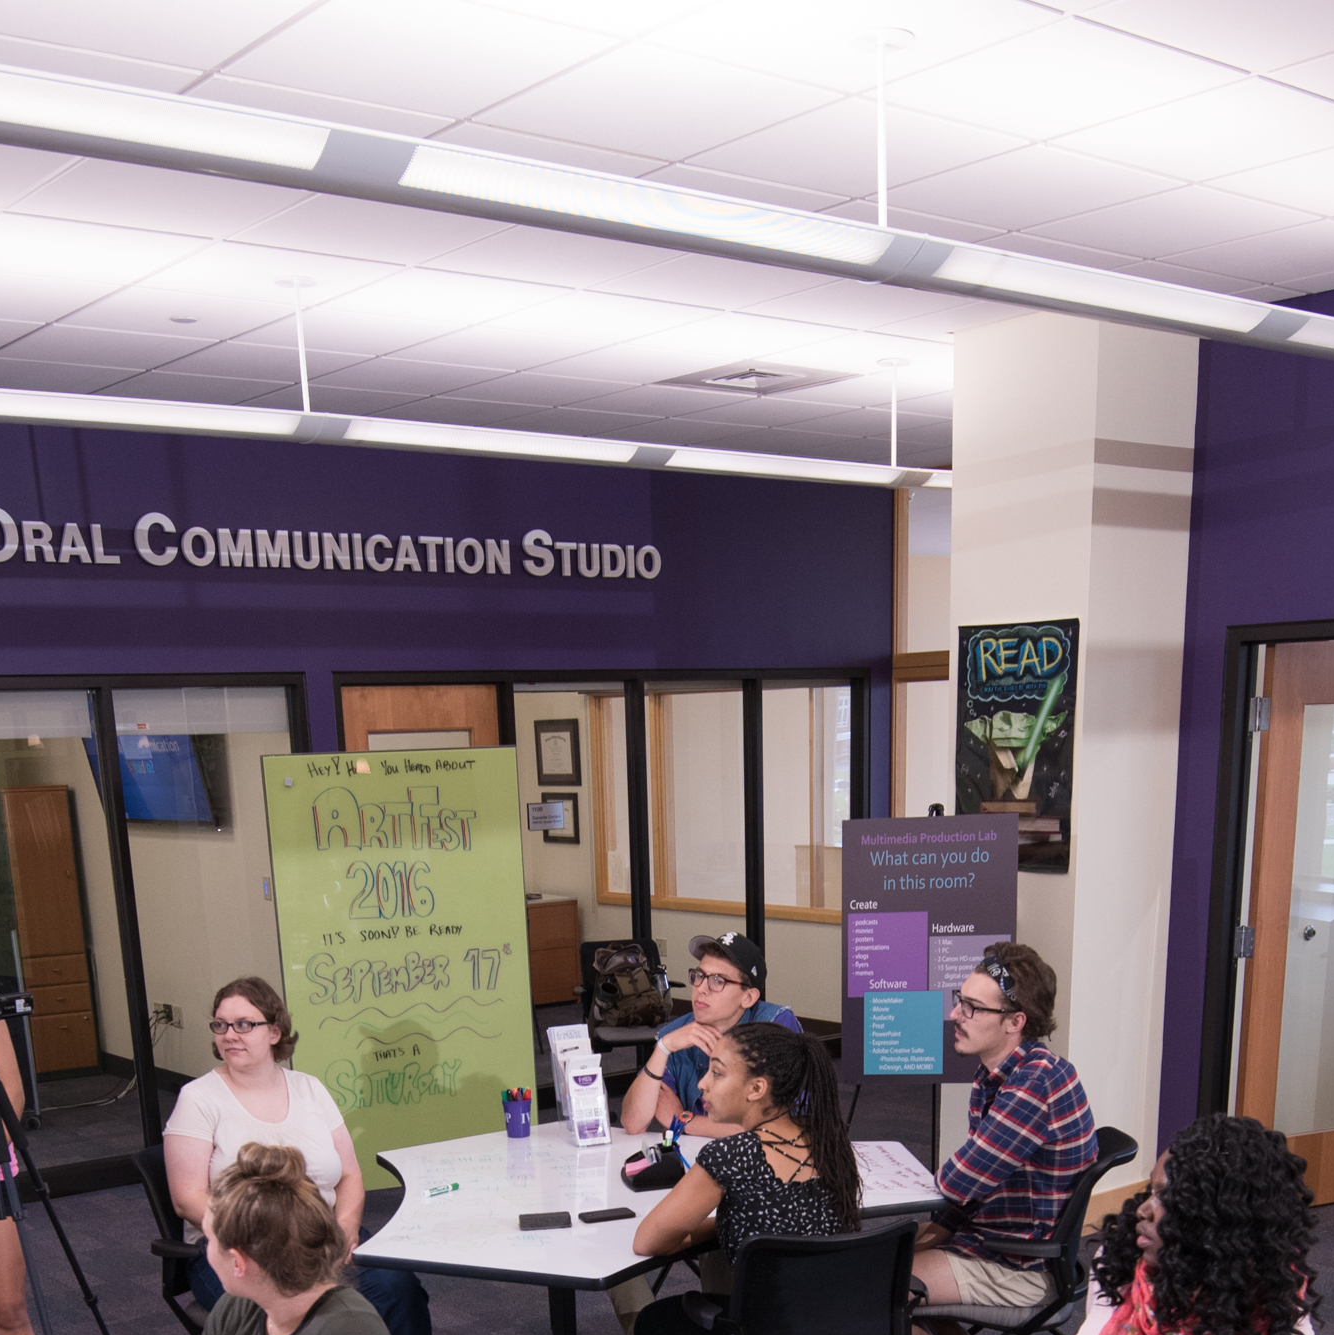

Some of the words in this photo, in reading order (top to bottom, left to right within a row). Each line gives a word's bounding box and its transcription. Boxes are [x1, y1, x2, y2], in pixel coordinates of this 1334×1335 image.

[133, 512, 512, 576] COMMUNICATION
[521, 529, 663, 580] STUDIO
[976, 637, 1064, 681] READ
[435, 760, 475, 771] ABOUT
[312, 786, 476, 851] ARTFEST
[861, 833, 918, 846] Multimedia
[920, 831, 976, 844] Production
[978, 829, 997, 841] Lab
[870, 850, 910, 866] What
[912, 852, 937, 865] can
[940, 851, 967, 868] you
[970, 847, 990, 863] do
[883, 876, 896, 890] in
[899, 875, 925, 890] this
[929, 873, 975, 889] room?
[346, 861, 435, 919] 2016
[849, 899, 878, 911] Create
[322, 931, 346, 946] IT'S
[405, 926, 421, 938] BE
[429, 925, 463, 937] READY
[932, 923, 974, 933] Hardware
[855, 944, 890, 952] presentations
[855, 953, 869, 961] vlogs
[945, 964, 958, 972] Sony
[305, 952, 450, 1005] SEPTEMBER
[869, 978, 907, 989] Software
[945, 972, 961, 980] digital
[872, 1014, 895, 1022] Audacity
[412, 1043, 421, 1058] A
[872, 1039, 899, 1047] Expression
[324, 1058, 463, 1113] SATURDAY
